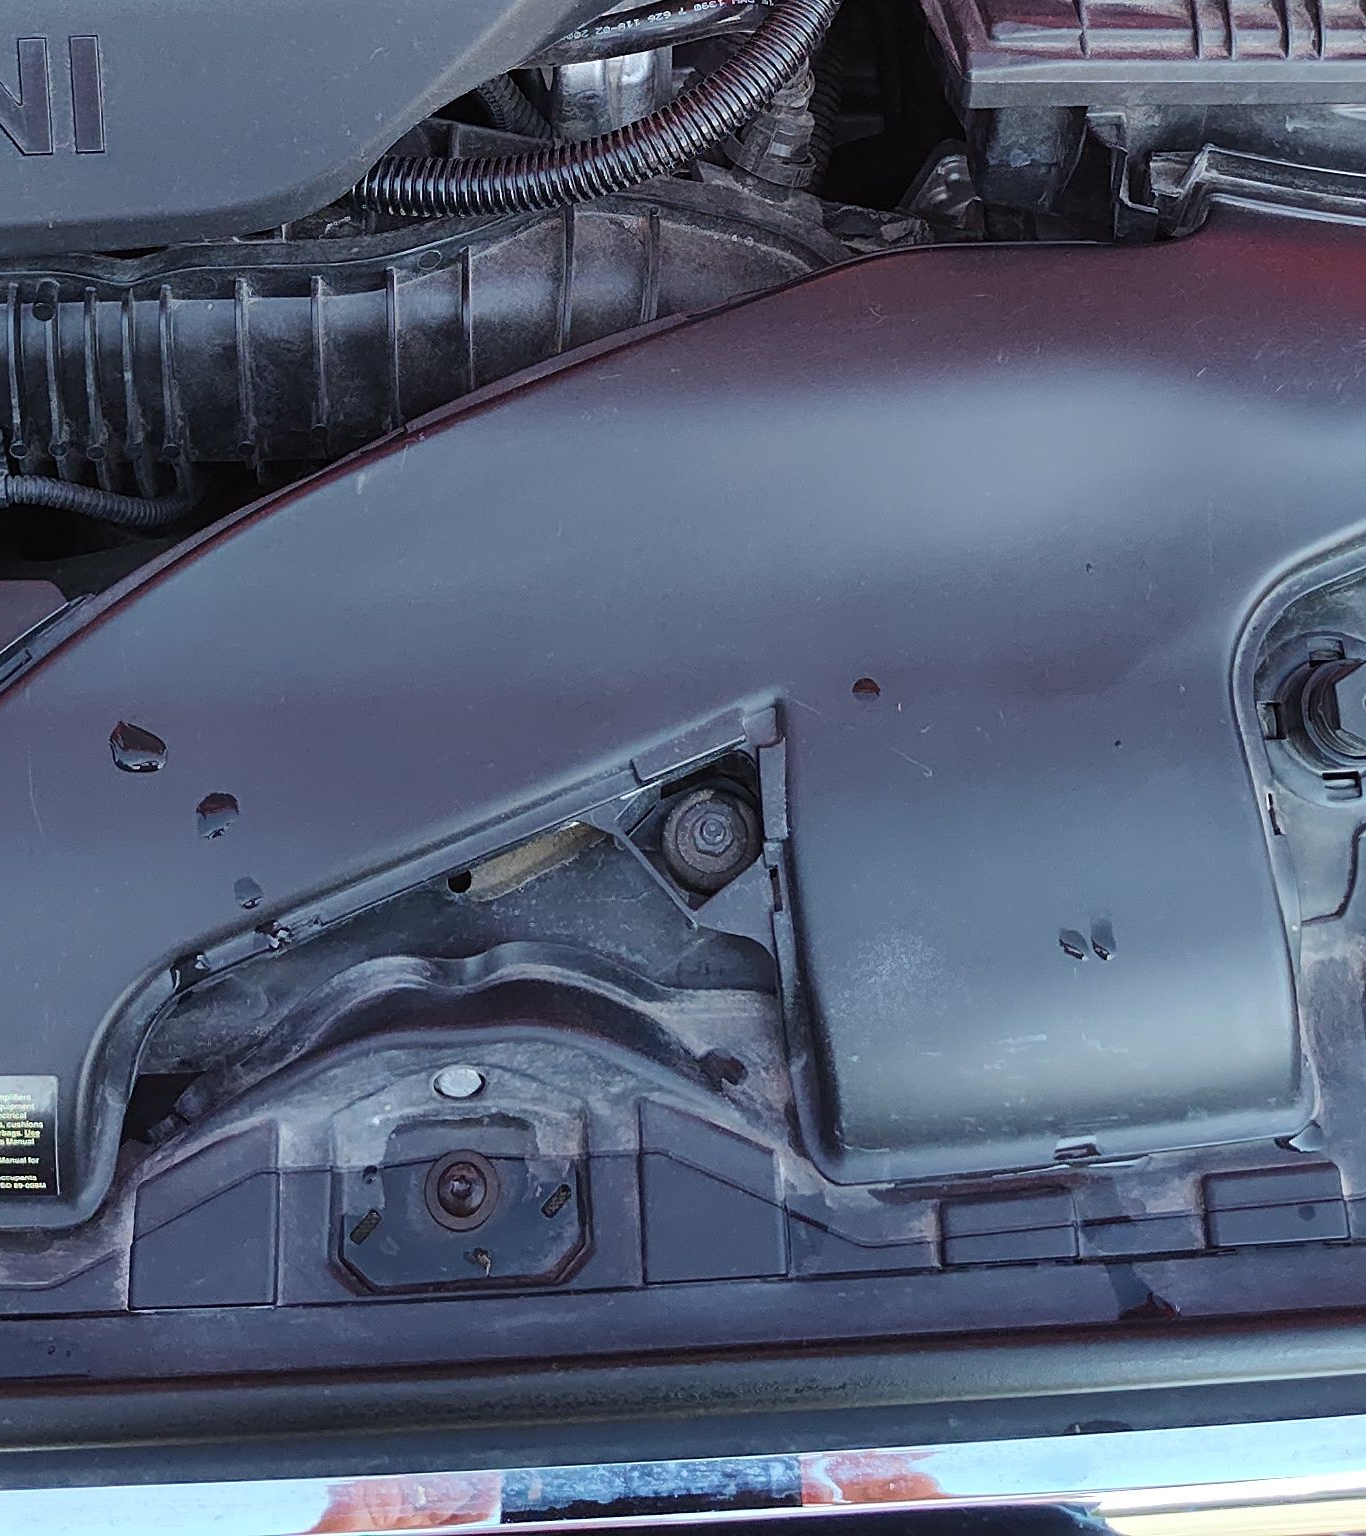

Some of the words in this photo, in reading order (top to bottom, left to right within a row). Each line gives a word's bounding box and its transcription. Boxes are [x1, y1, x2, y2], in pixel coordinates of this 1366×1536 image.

[646, 10, 672, 23] 626
[6, 1120, 43, 1128] cushions
[24, 1129, 41, 1138] Use
[6, 1137, 34, 1146] Manual
[28, 1156, 39, 1164] for
